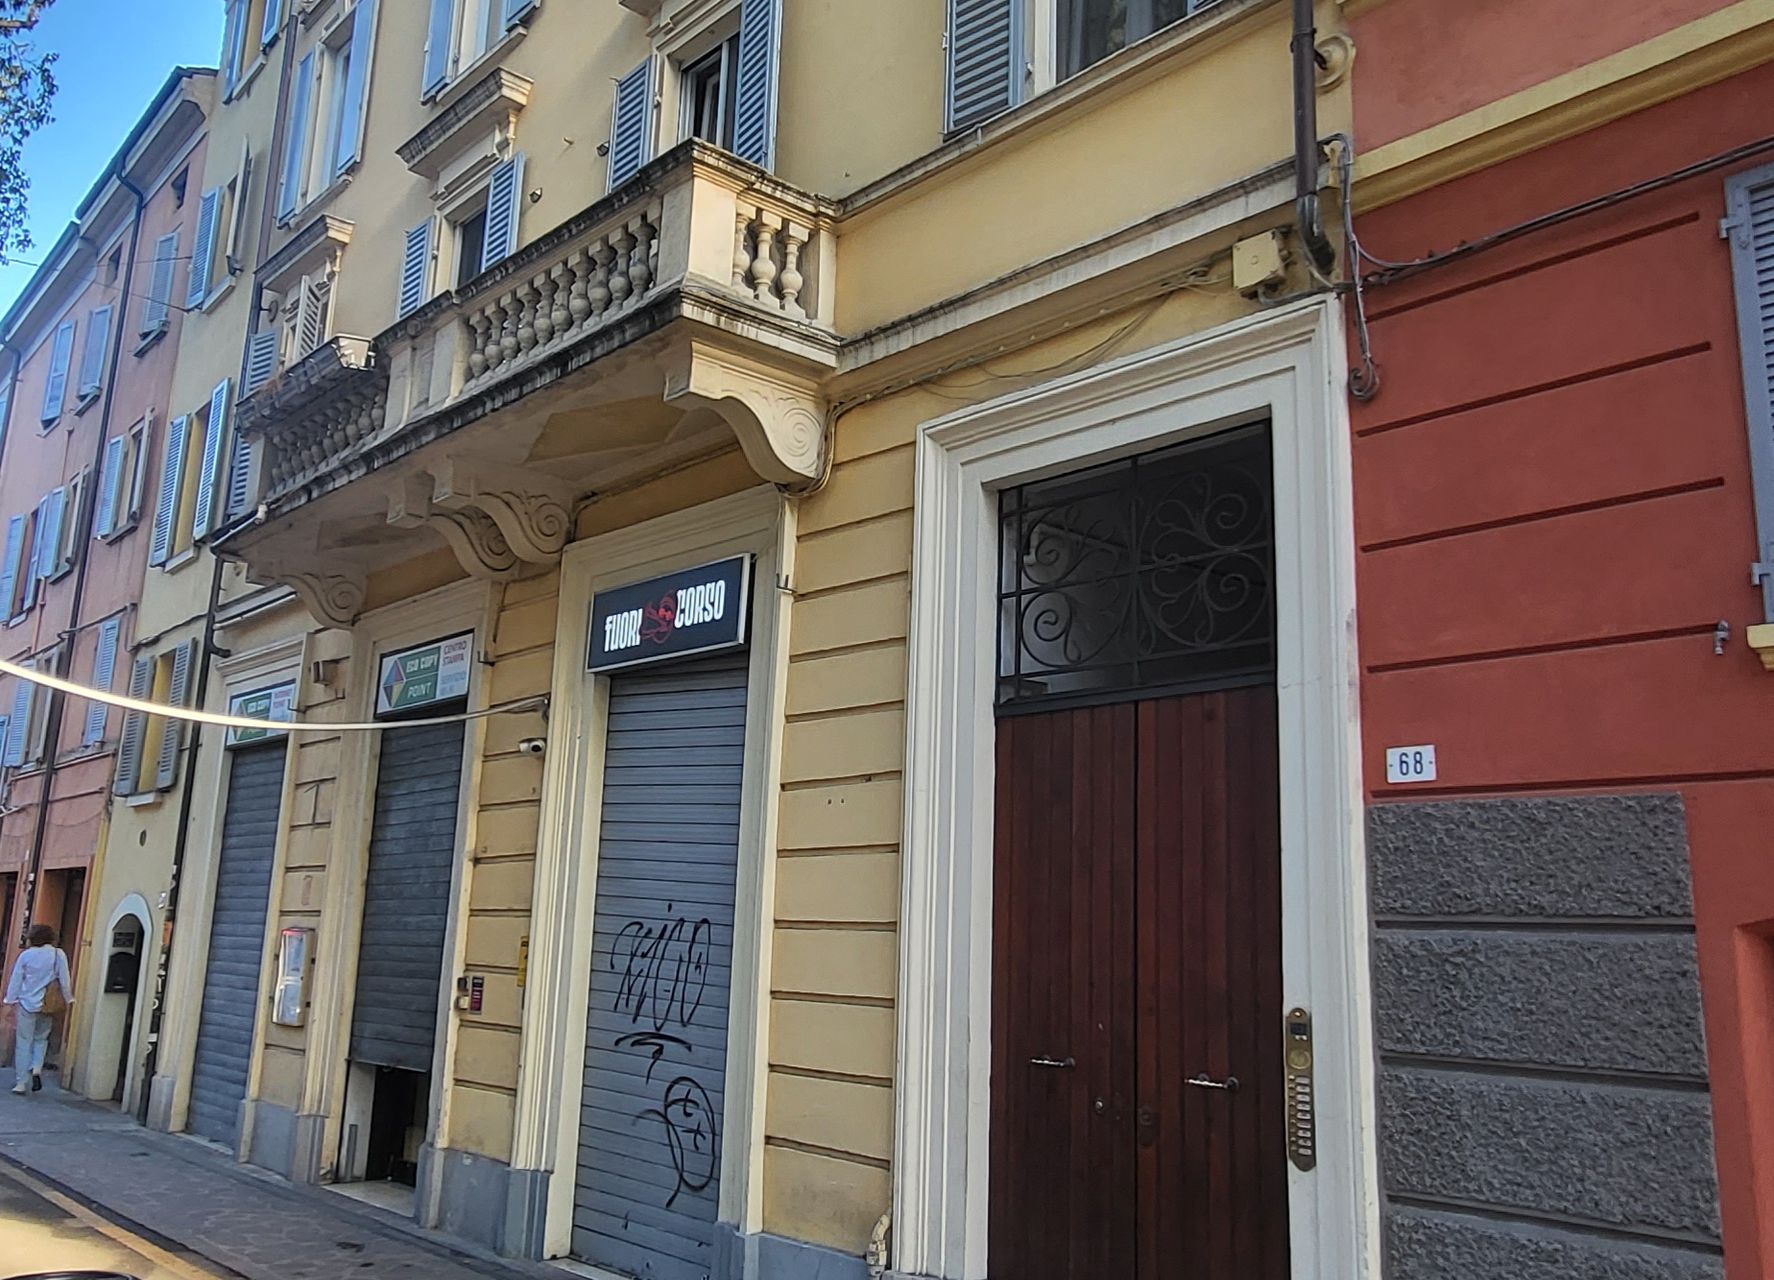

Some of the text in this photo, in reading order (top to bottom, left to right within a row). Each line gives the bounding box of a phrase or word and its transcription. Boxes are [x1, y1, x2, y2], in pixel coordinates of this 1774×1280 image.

[674, 580, 726, 628] CORSO
[420, 653, 439, 670] COPY
[407, 682, 432, 699] POINT
[1399, 750, 1424, 776] 68
